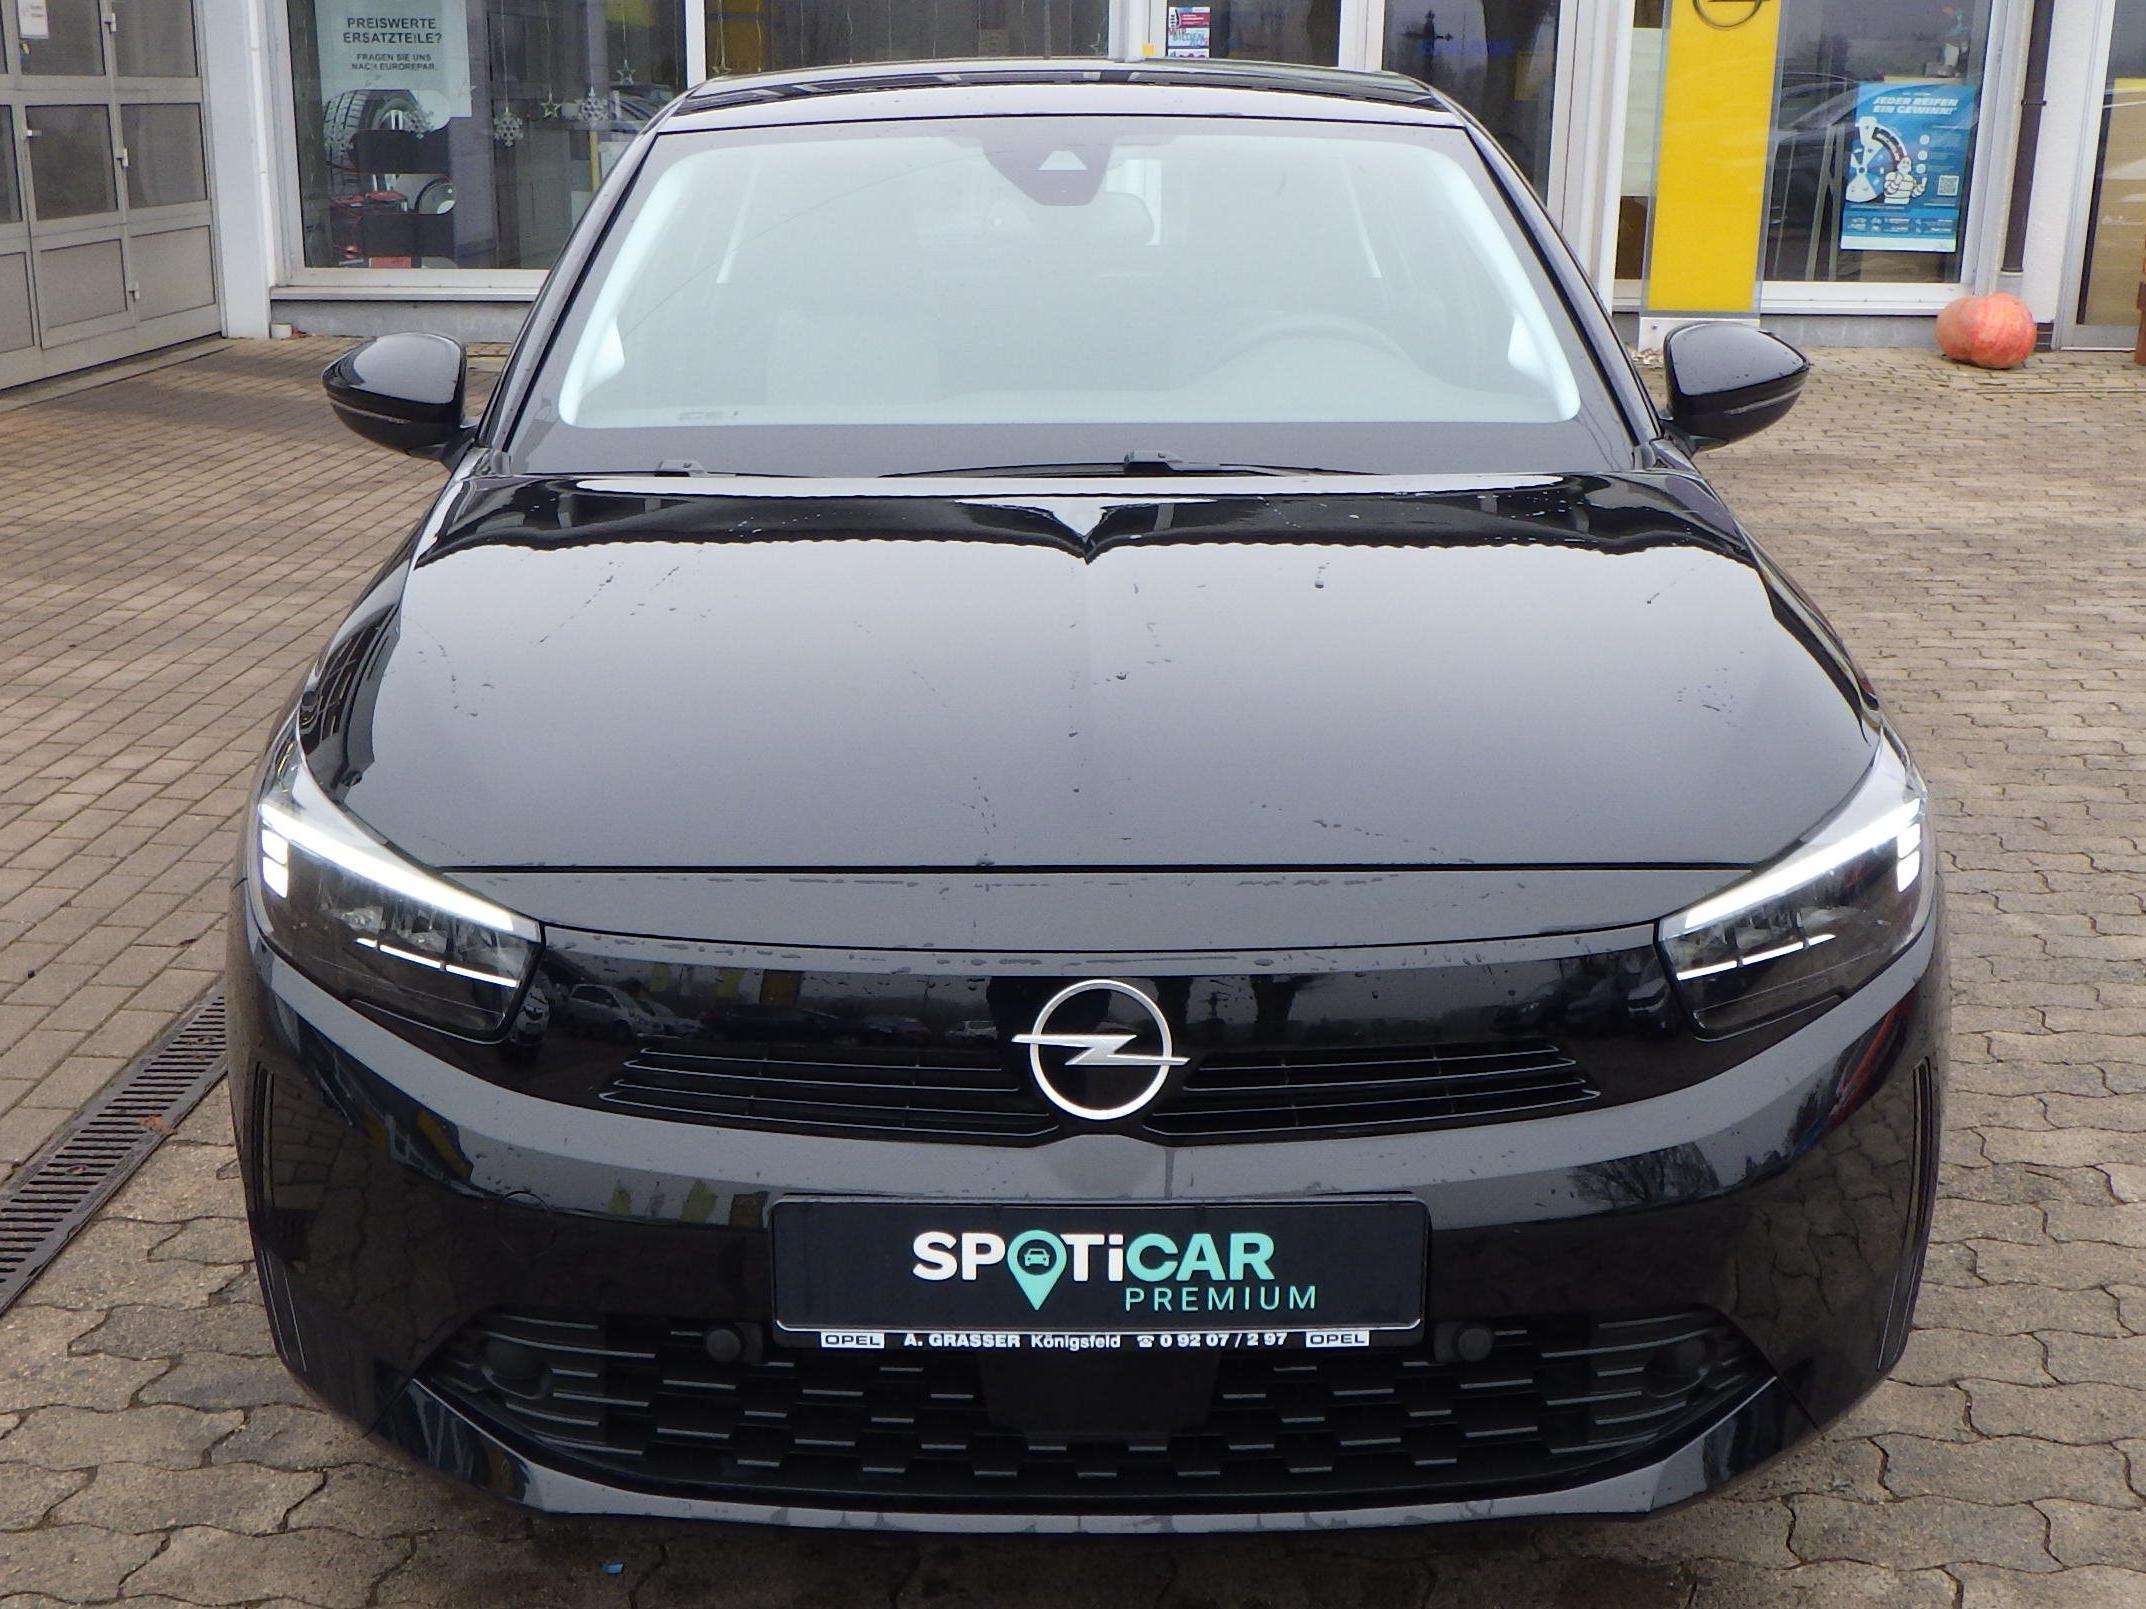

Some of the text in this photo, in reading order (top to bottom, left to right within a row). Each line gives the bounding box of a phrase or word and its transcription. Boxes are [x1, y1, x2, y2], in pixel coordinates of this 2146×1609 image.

[347, 17, 436, 29] PREISWERTE
[343, 32, 442, 44] ERSATZTEILE?
[356, 53, 394, 61] FRAGEN
[413, 53, 432, 61] UNS
[1125, 1285, 1317, 1312] PREMIUM
[825, 1335, 881, 1346] OPEL
[904, 1334, 923, 1347] A.
[928, 1334, 1021, 1348] GRASSER
[1030, 1334, 1121, 1351] Königsfeld
[1177, 1334, 1201, 1347] 92
[1206, 1333, 1230, 1347] 07
[1263, 1332, 1288, 1346] 97
[1310, 1334, 1366, 1345] OPEL
